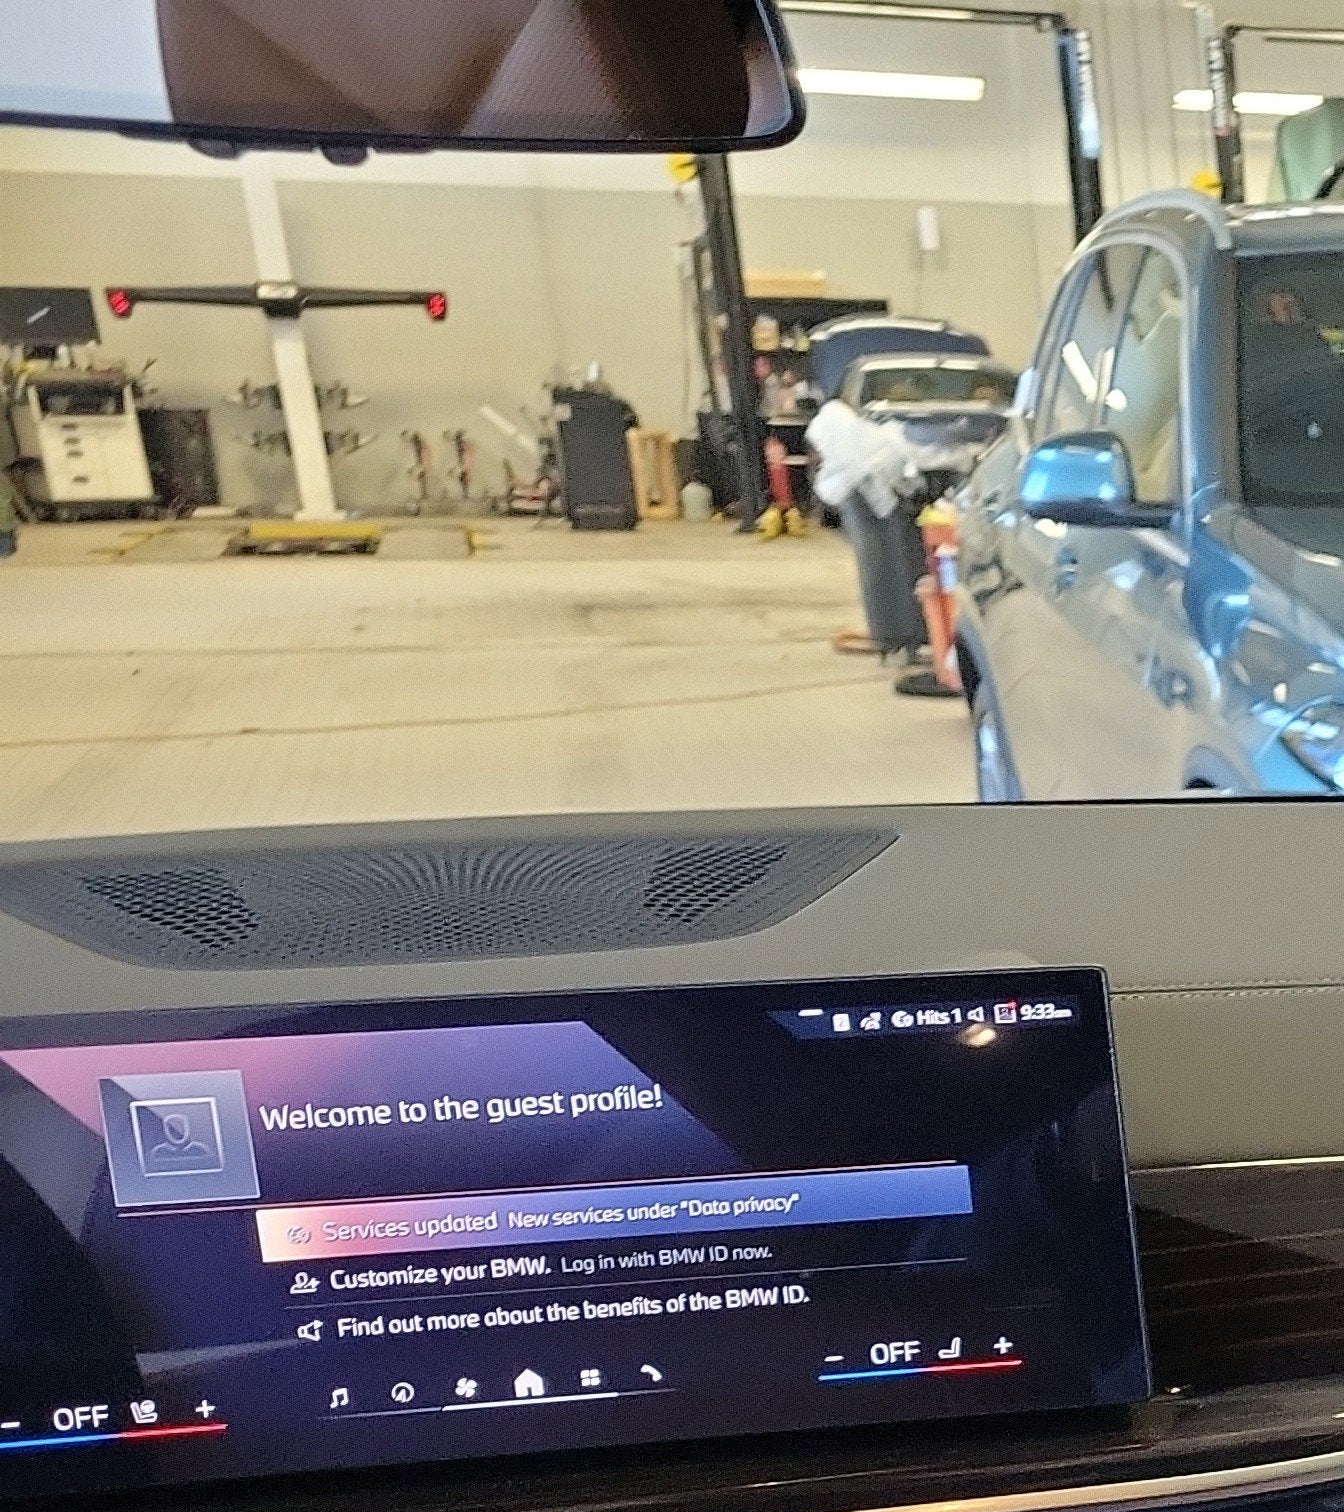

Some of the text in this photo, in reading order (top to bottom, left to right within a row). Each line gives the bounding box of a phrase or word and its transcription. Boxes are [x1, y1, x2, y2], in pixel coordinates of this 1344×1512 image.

[916, 1007, 962, 1025] Hits 1
[258, 1083, 663, 1131] Welcome to the guest profile!
[322, 1193, 800, 1241] Services updated New services under "Data privacy"
[330, 1245, 773, 1290] Customize your BMW. Log in with BMW ID now.
[337, 1284, 811, 1338] Find out more about the benefits of the BMW ID.
[870, 1340, 921, 1365] OFF
[53, 1404, 109, 1431] OFF
